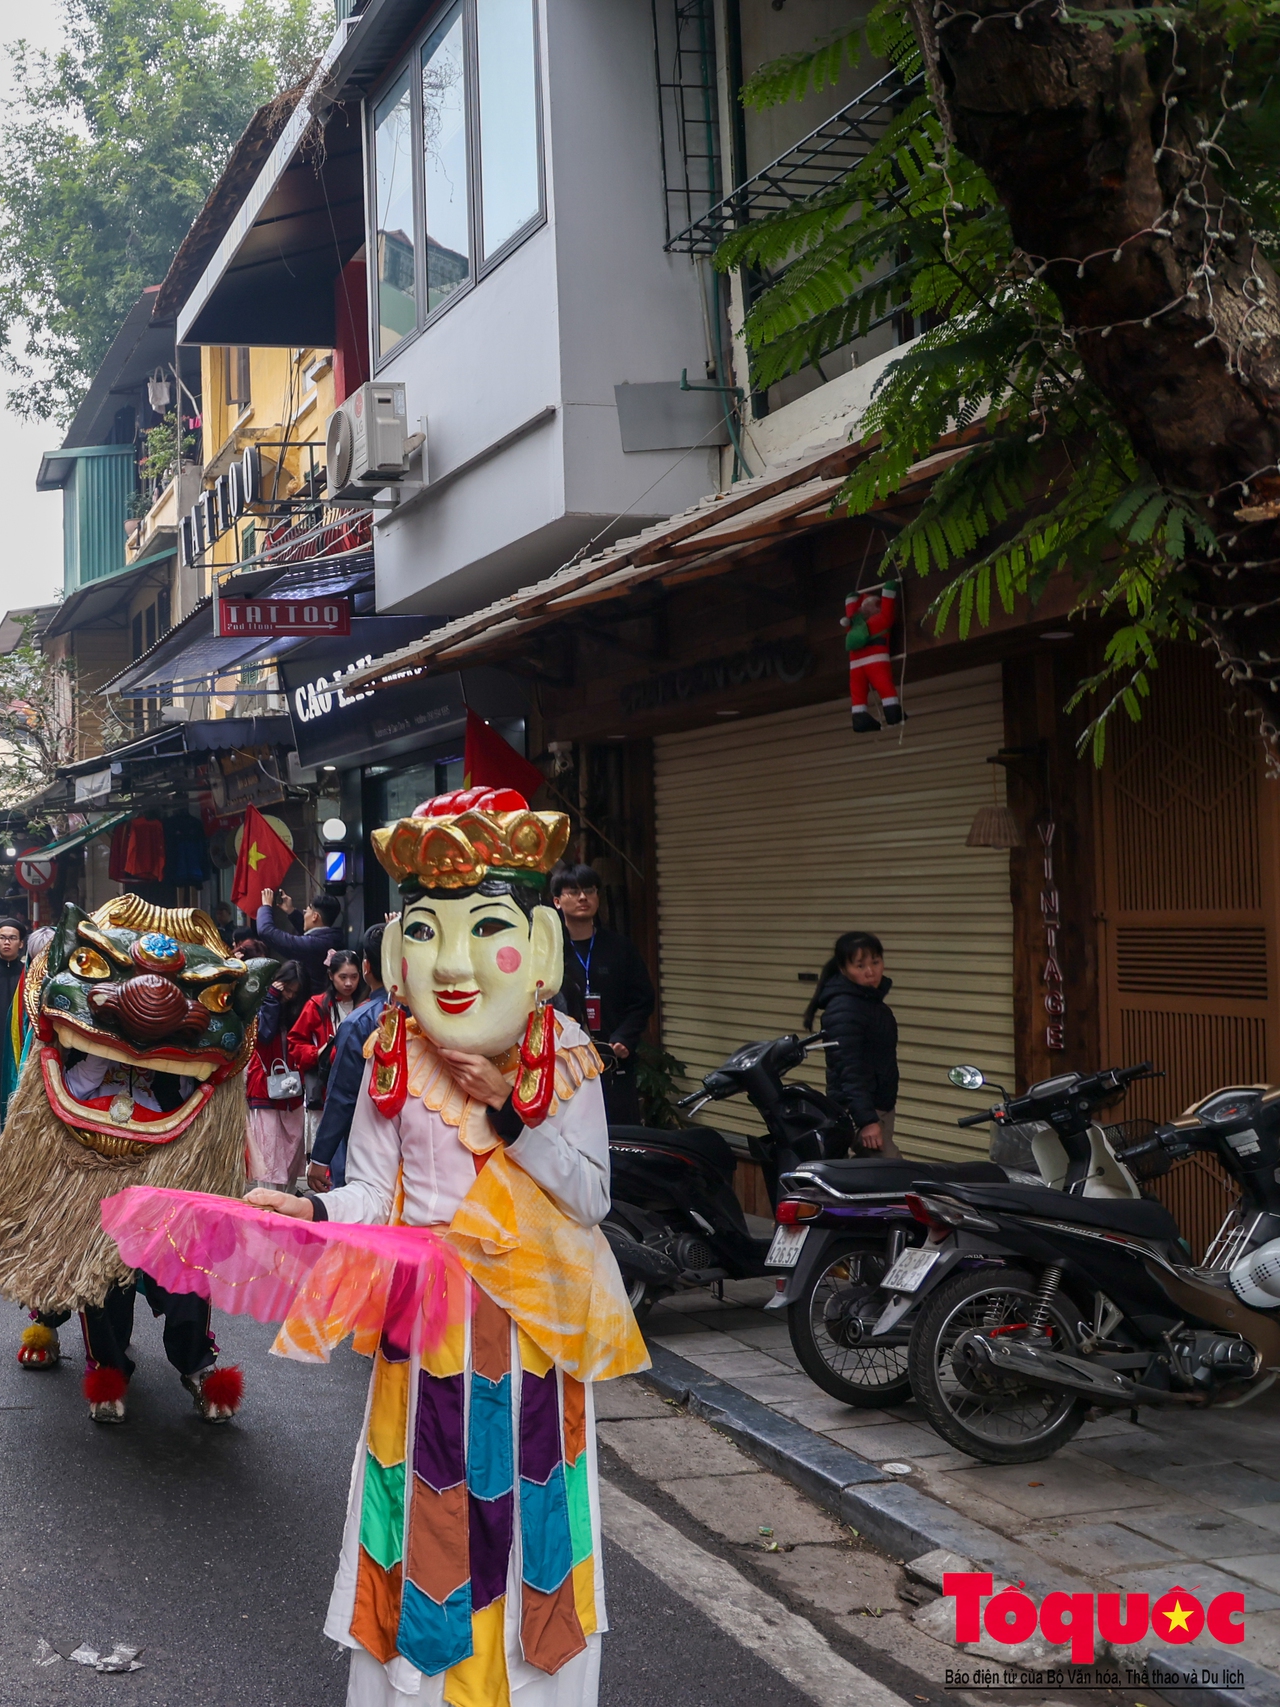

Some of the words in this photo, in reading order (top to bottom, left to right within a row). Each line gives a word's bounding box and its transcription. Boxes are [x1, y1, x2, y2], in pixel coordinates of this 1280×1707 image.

[356, 420, 363, 435] LG
[179, 446, 253, 566] TATTOO
[227, 606, 339, 623] TATTOO
[295, 677, 332, 723] CAO
[1037, 823, 1066, 1049] VINTAGE
